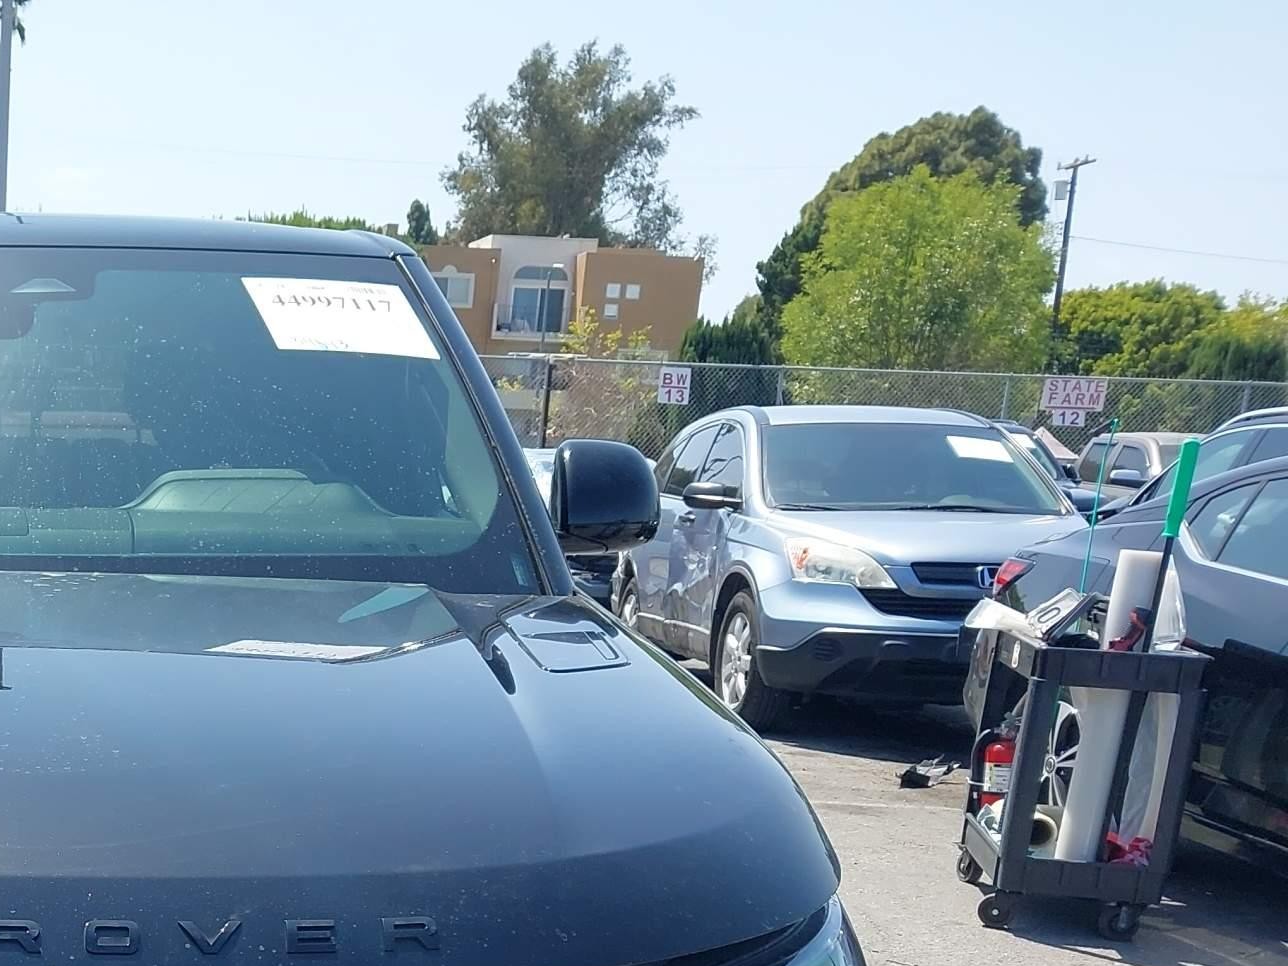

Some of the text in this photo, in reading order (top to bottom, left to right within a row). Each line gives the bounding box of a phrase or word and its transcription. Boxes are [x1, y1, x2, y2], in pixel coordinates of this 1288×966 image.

[271, 293, 392, 313] 44997117
[662, 372, 688, 386] BW
[1048, 379, 1105, 393] STATE
[664, 388, 685, 403] 13
[1047, 392, 1101, 406] FARM
[1058, 410, 1080, 425] 12
